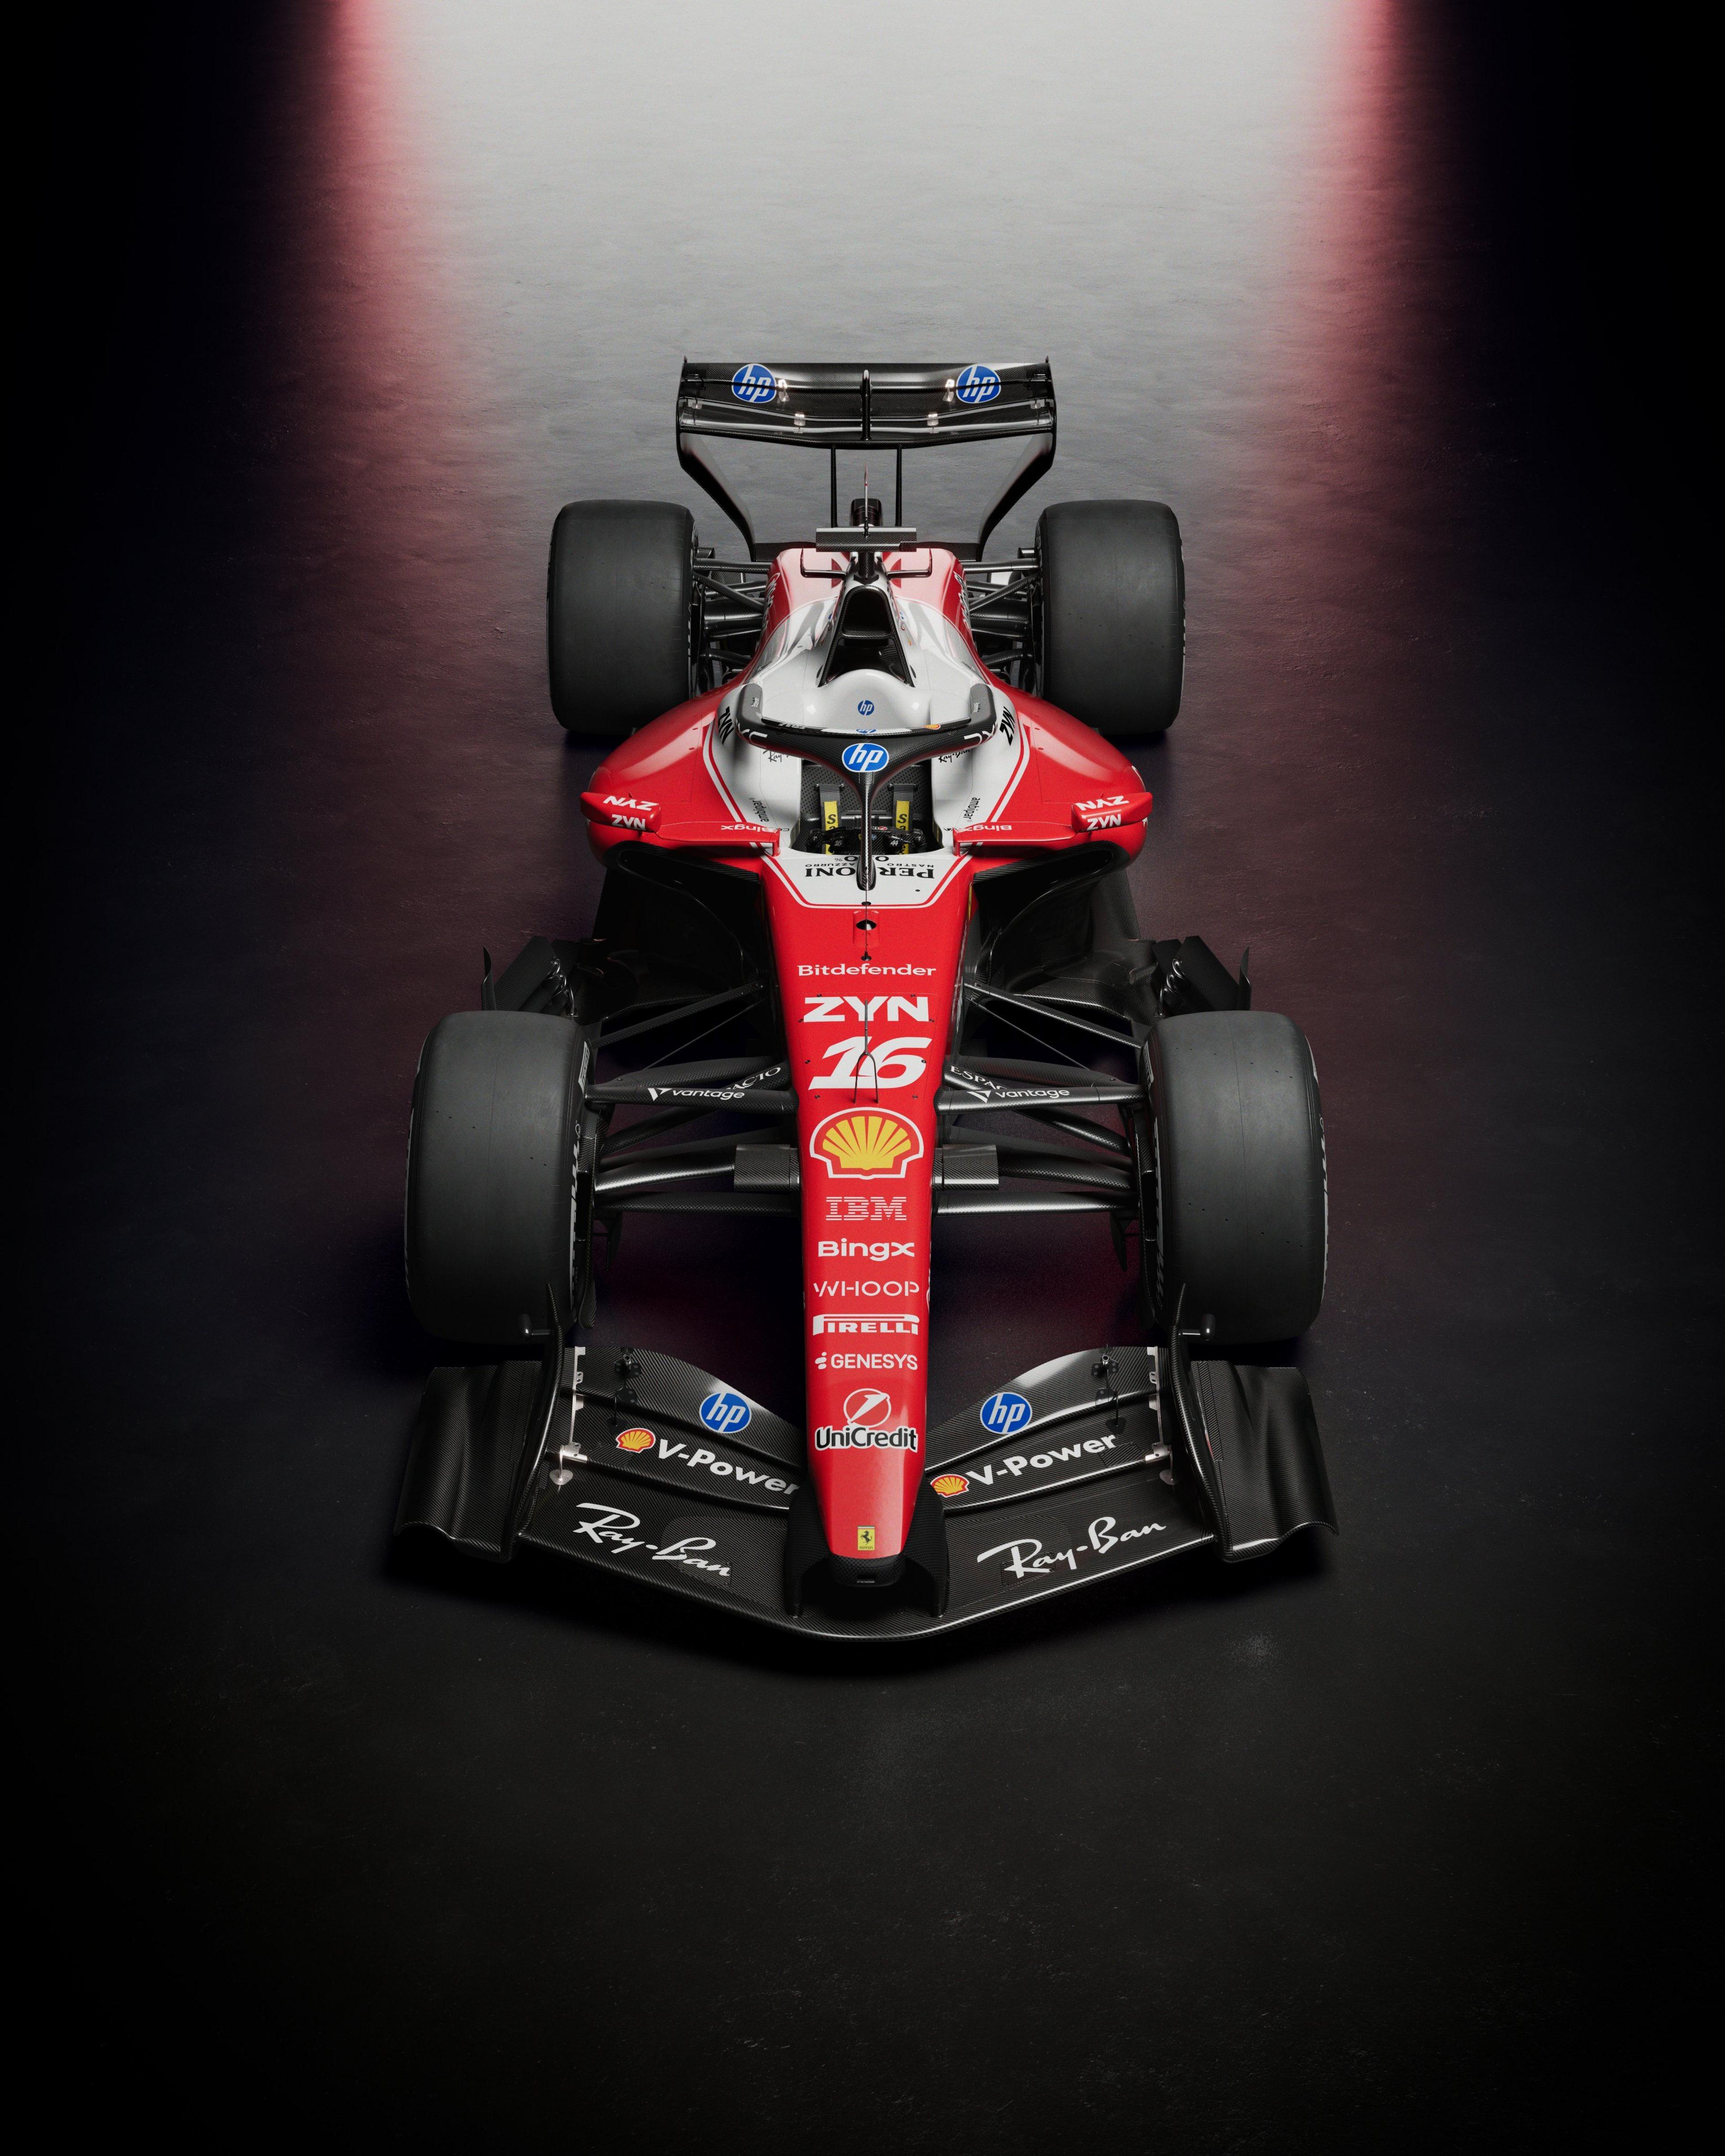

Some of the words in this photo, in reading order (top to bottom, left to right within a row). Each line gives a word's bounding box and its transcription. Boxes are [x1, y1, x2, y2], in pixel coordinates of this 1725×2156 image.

[739, 364, 773, 403] hp
[964, 364, 996, 403] hp
[859, 700, 873, 716] hp
[1000, 706, 1015, 746] ZYN
[849, 744, 884, 771] hp
[603, 795, 659, 811] ZYN
[1075, 795, 1129, 811] ZYN
[611, 814, 646, 830] ZYN
[1087, 814, 1122, 831] ZYN
[797, 963, 937, 976] Bitdefender
[803, 996, 929, 1023] ZYN
[808, 1036, 933, 1090] 16
[672, 1089, 745, 1100] vantage
[995, 1089, 1070, 1099] vantage
[826, 1196, 907, 1221] IBM
[813, 1280, 920, 1297] WHOOP
[813, 1314, 920, 1336] PIRELLI
[831, 1353, 918, 1370] GENESYS
[706, 1393, 747, 1433] hp
[988, 1392, 1024, 1434] hp
[815, 1426, 918, 1452] UniCredit
[657, 1439, 800, 1495] V-Power
[967, 1434, 1117, 1485] V-Power
[573, 1502, 731, 1577] Ray-Ban
[977, 1516, 1167, 1578] Ray-Ban
